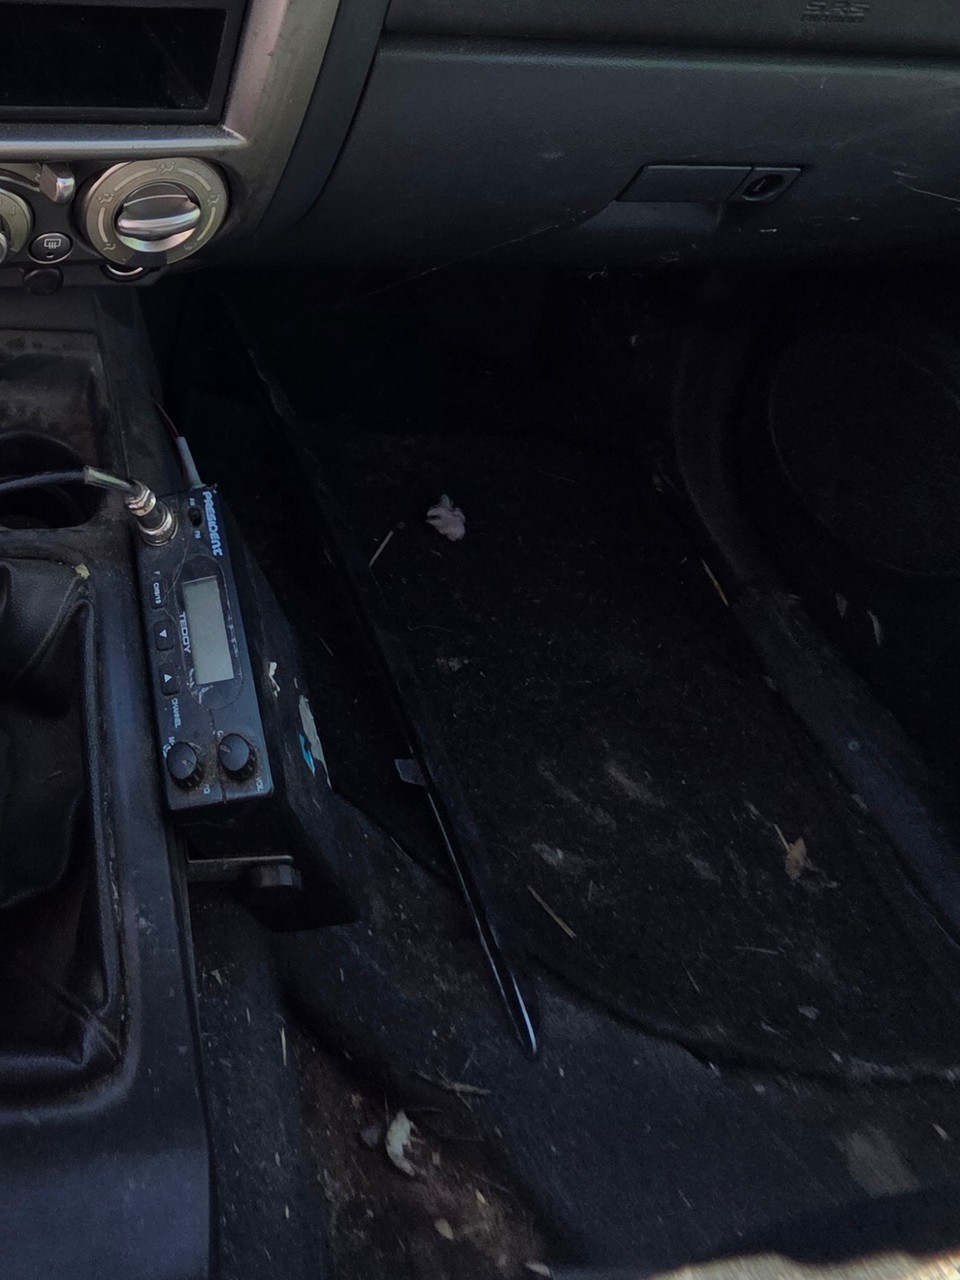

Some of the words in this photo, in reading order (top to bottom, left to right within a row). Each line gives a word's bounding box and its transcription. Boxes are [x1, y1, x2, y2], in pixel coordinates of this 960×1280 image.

[202, 490, 224, 557] PRESIDENT
[178, 610, 192, 654] TEDDY
[171, 697, 182, 729] CHANNEL
